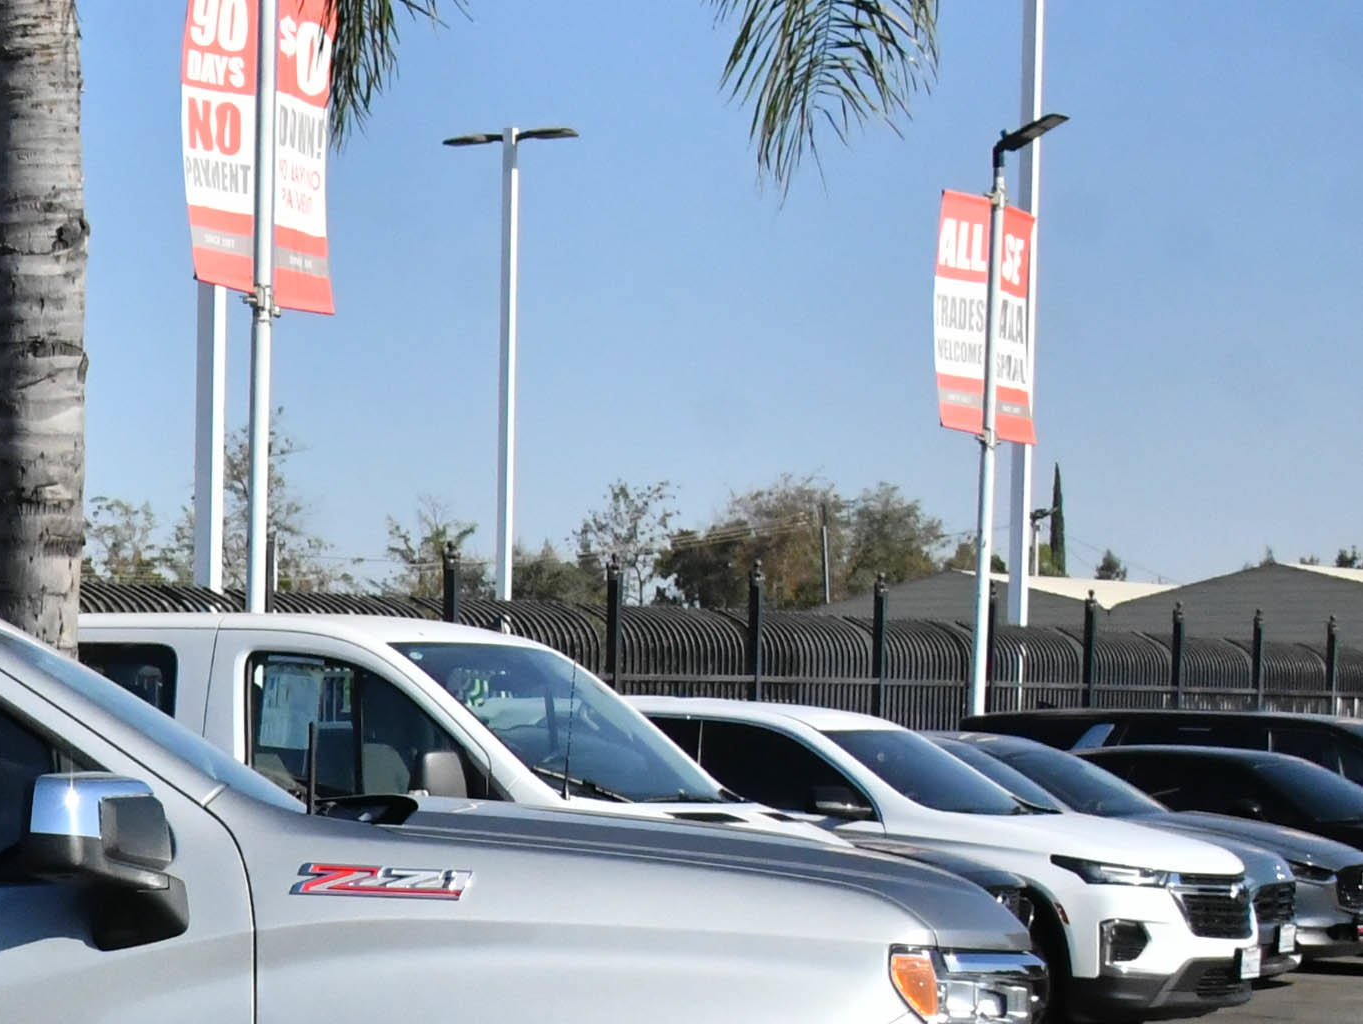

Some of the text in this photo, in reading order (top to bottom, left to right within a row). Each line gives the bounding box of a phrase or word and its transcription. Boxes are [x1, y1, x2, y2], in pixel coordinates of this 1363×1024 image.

[186, 49, 246, 89] DAYS
[279, 15, 333, 96] $0
[187, 97, 242, 156] NO
[938, 217, 987, 272] ALL
[936, 293, 986, 333] TRADES
[289, 862, 476, 901] Z71
